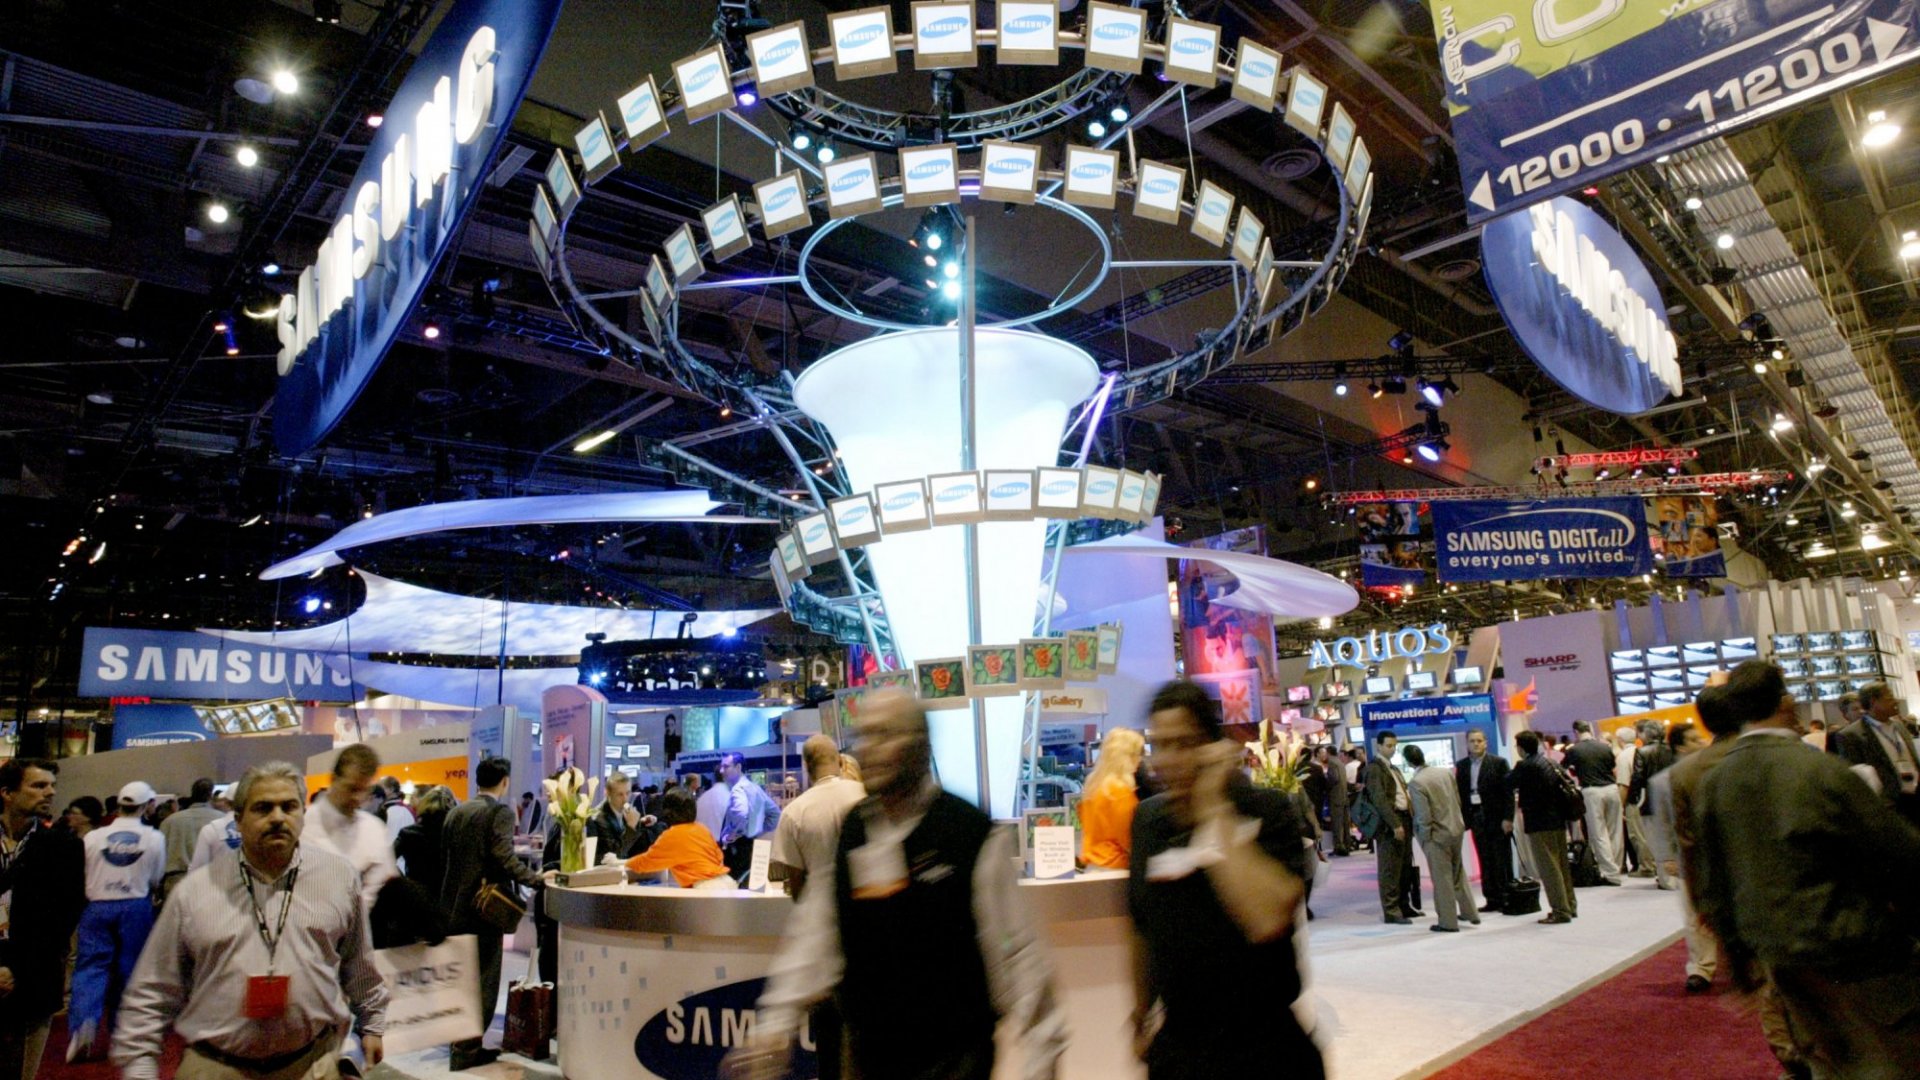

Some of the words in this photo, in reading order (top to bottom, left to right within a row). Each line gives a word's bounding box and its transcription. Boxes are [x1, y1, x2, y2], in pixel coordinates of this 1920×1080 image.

[1440, 5, 1468, 95] MOMENT
[1498, 118, 1646, 197] 12000
[1685, 32, 1863, 124] 11200
[1447, 530, 1544, 552] SAMSUNG
[1449, 552, 1550, 569] everyone's
[1558, 550, 1624, 564] invited
[1308, 622, 1452, 670] AQUOS
[1524, 654, 1577, 666] SHARP
[1051, 695, 1084, 708] Gallery
[1369, 707, 1439, 720] Innovations
[1443, 704, 1490, 716] Awards
